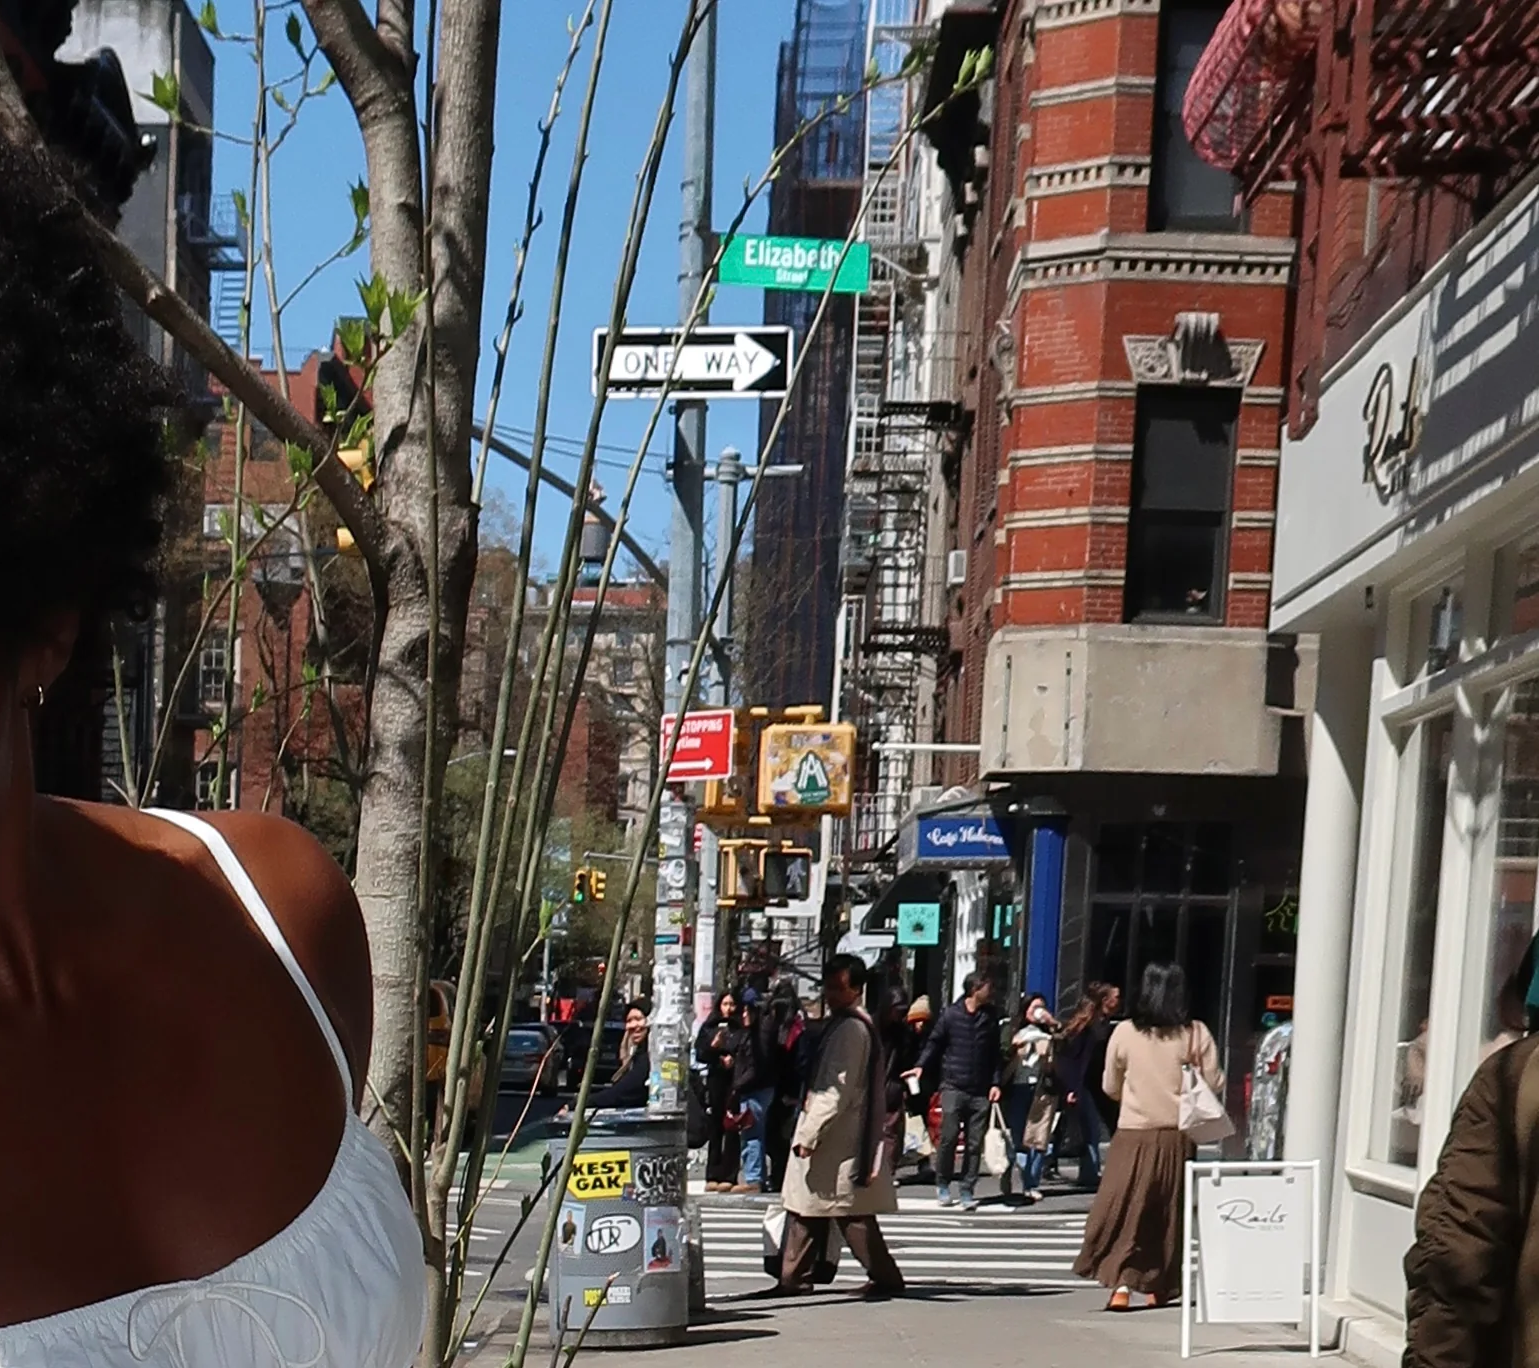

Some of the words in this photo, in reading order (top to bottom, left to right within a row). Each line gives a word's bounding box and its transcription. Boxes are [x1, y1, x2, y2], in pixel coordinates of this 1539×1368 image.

[745, 238, 841, 271] Elizabeth
[624, 350, 676, 375] ONE
[704, 350, 760, 375] WAY
[573, 1159, 629, 1176] KEST
[576, 1175, 622, 1191] GAK
[1216, 1198, 1289, 1230] Rails
